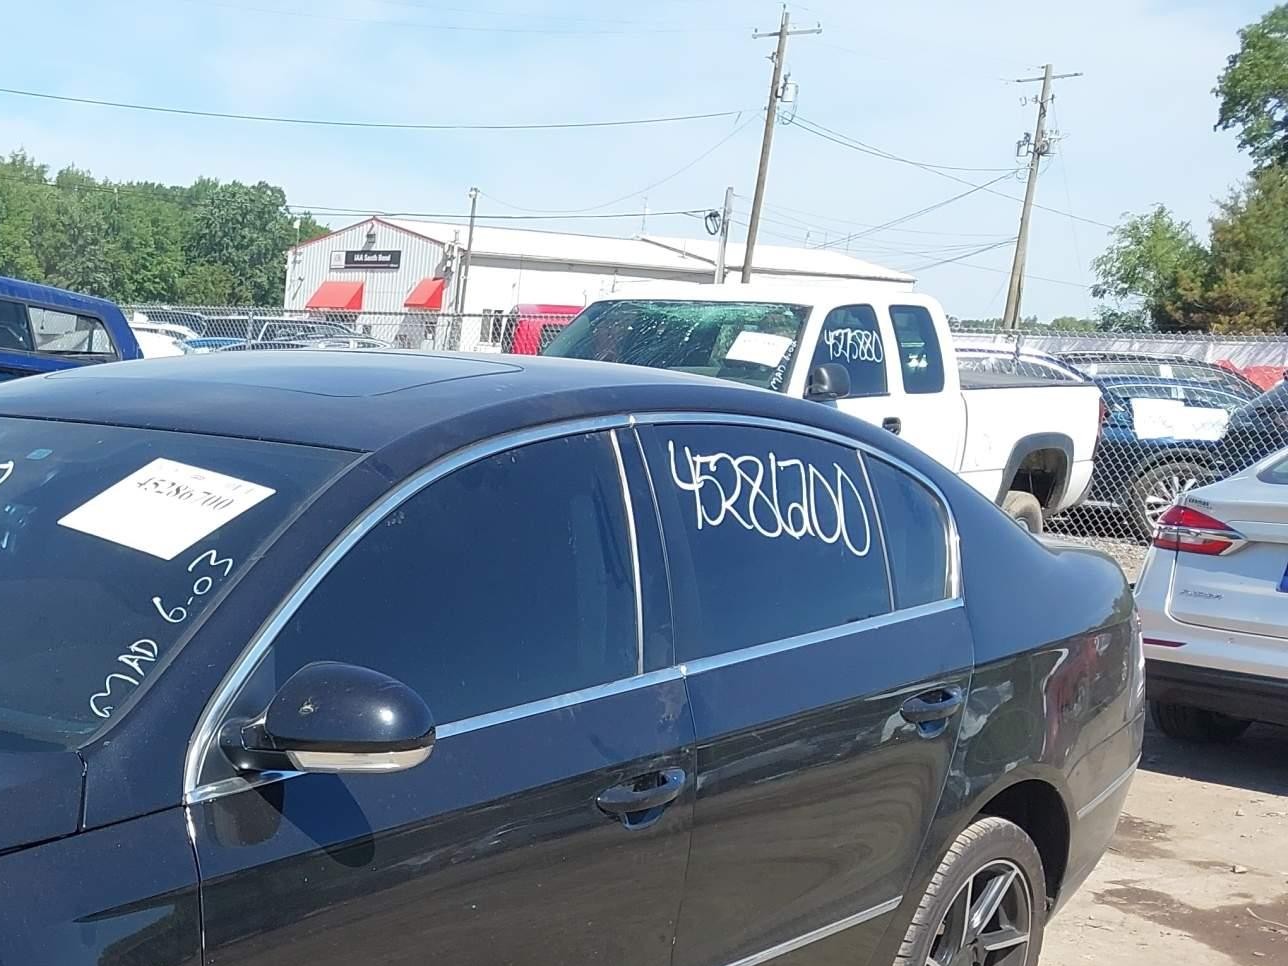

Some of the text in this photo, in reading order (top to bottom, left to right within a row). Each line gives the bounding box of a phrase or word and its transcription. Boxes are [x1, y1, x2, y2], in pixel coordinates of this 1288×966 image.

[824, 328, 883, 363] 45275880
[770, 364, 786, 390] MAD
[136, 476, 235, 511] 45286700
[89, 549, 233, 718] MAD 6-03
